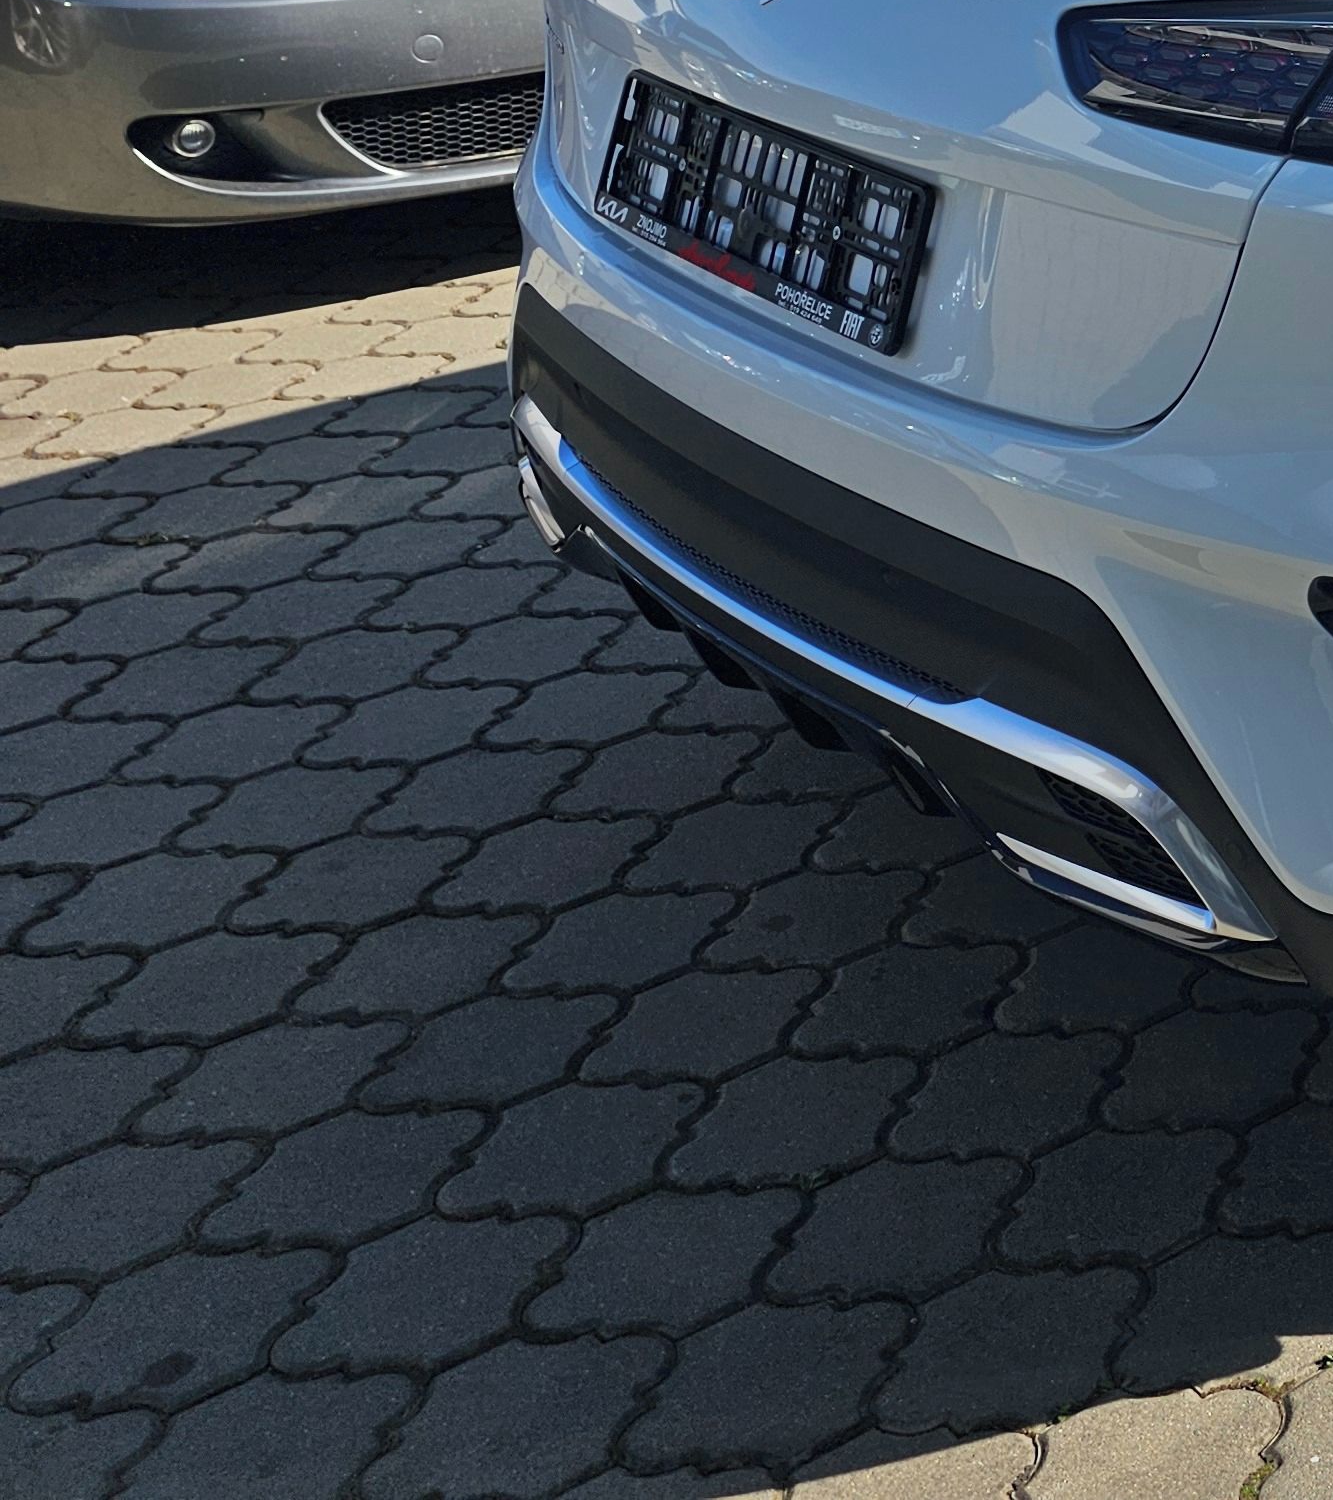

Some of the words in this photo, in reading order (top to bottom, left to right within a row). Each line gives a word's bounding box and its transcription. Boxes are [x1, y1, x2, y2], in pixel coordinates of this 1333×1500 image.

[596, 196, 628, 223] KIA
[636, 213, 668, 239] ZNOJMO
[774, 282, 833, 321] POHOŘELICE
[839, 309, 866, 340] FIAT
